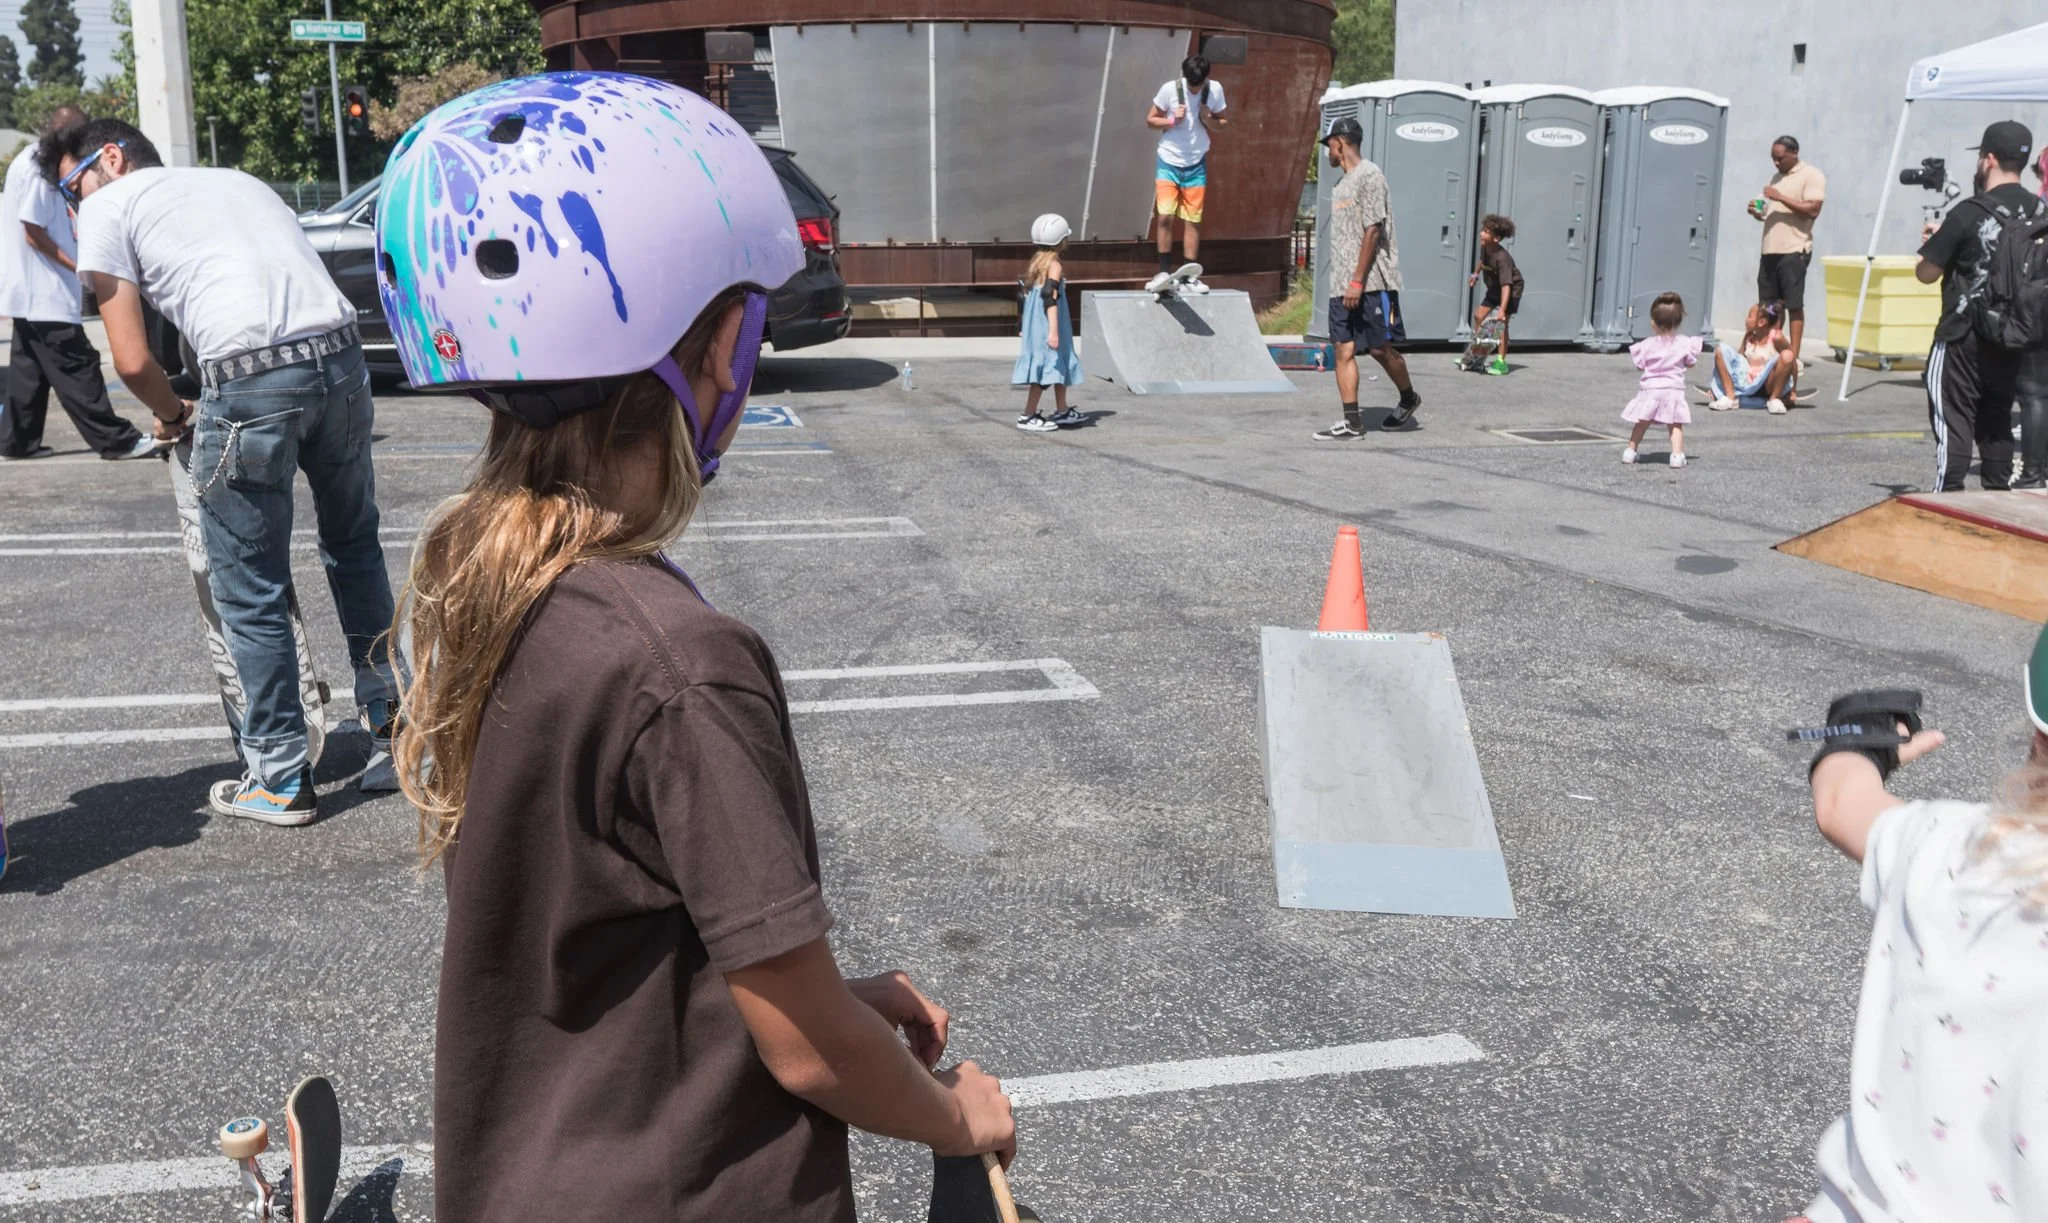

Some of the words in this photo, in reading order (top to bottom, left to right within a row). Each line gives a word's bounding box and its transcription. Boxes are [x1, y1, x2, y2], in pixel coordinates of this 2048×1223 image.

[306, 23, 340, 34] National
[343, 24, 362, 35] Blvd
[1411, 126, 1445, 136] AndyGump
[1541, 131, 1573, 142] AndyGump
